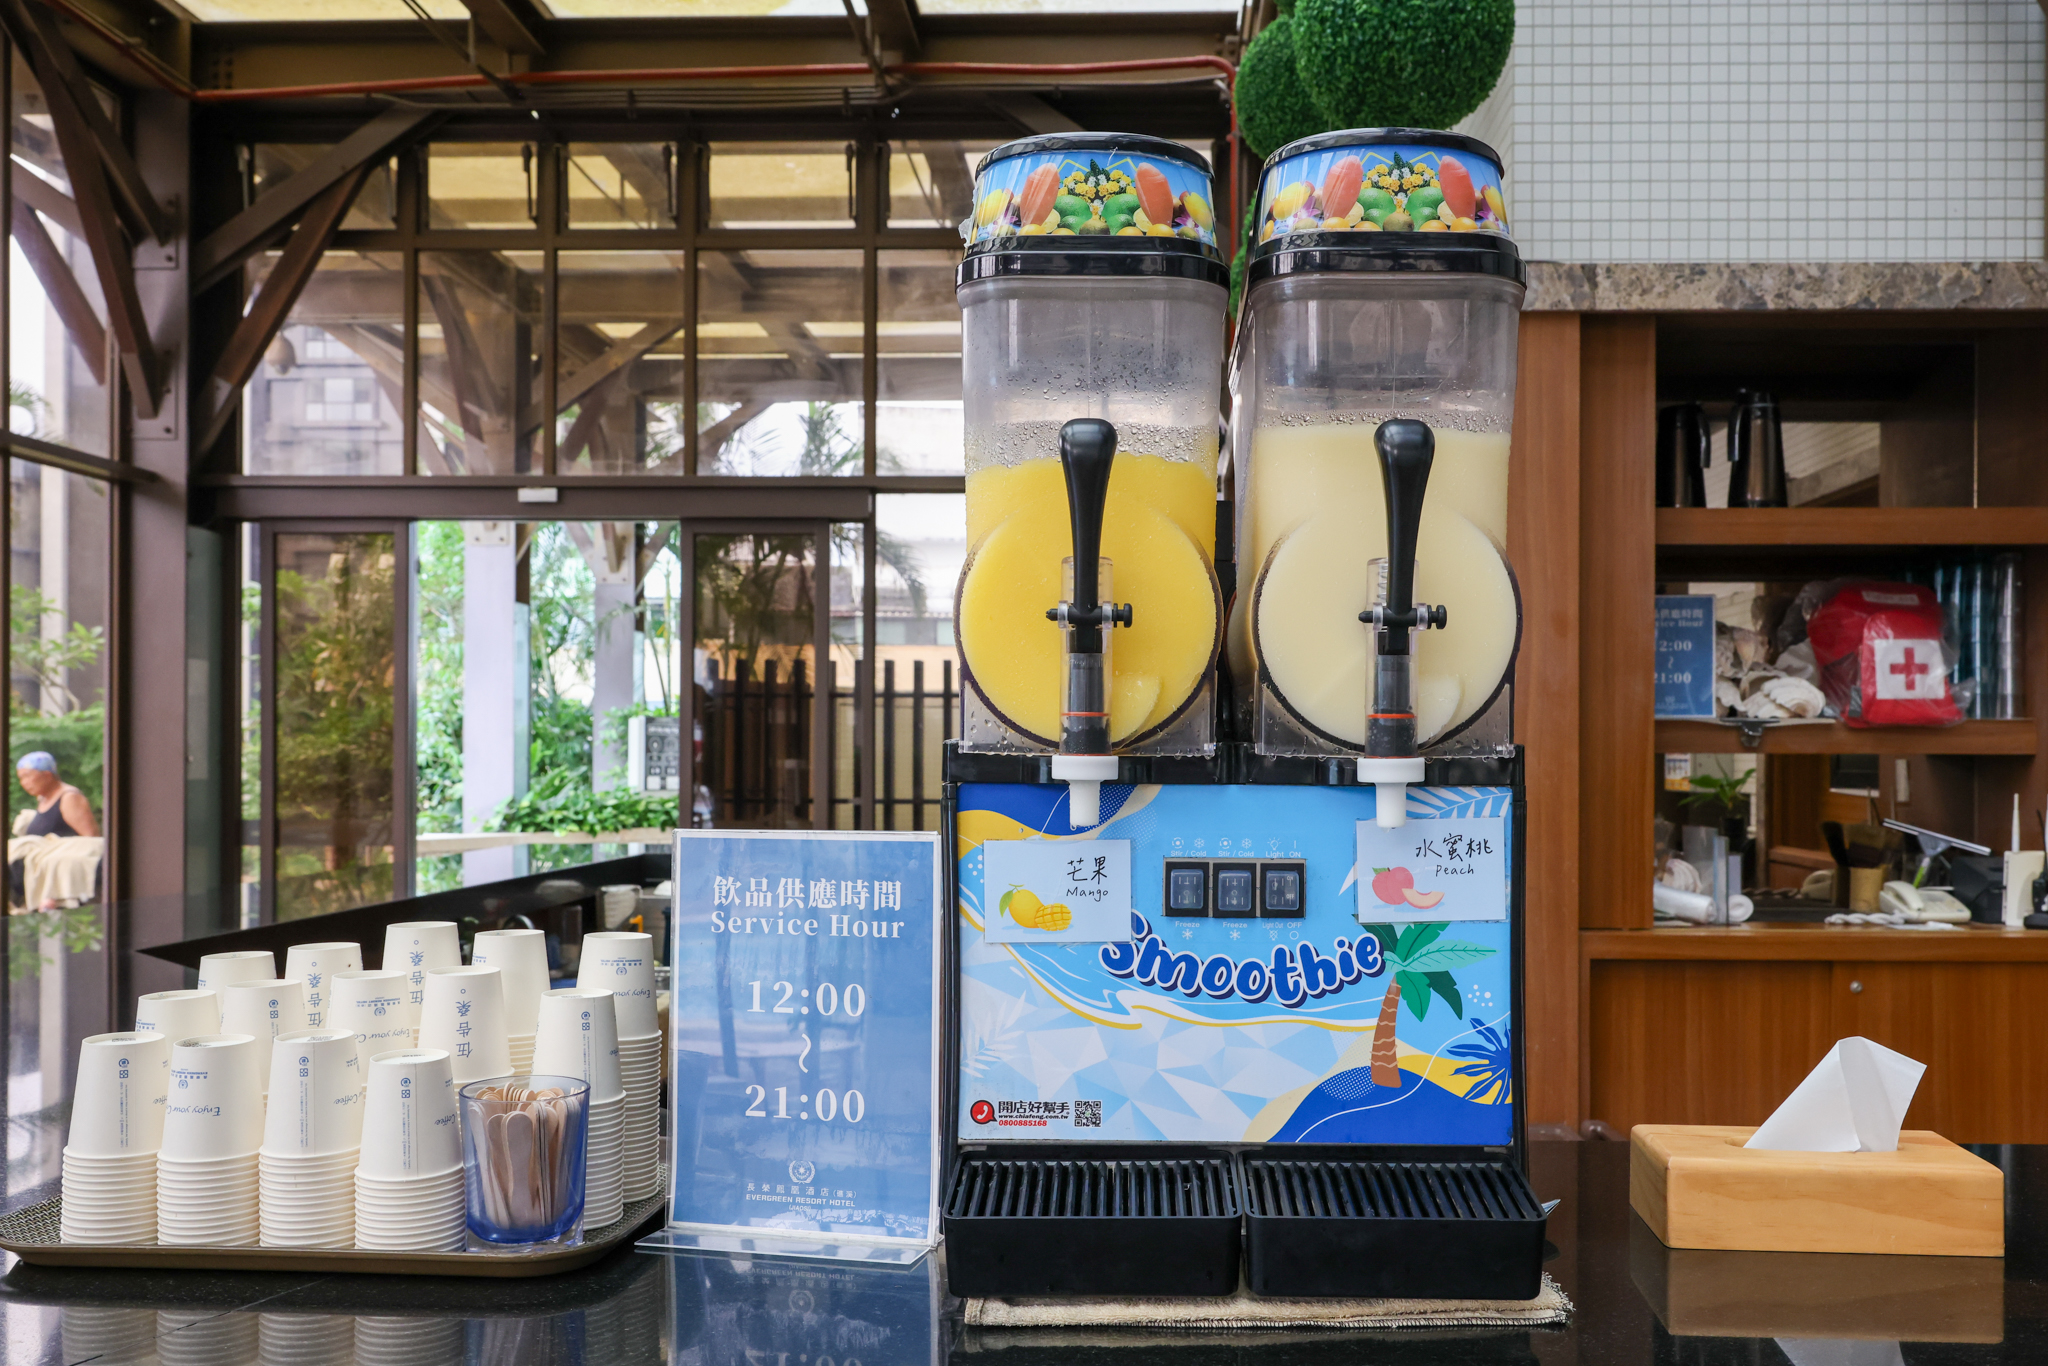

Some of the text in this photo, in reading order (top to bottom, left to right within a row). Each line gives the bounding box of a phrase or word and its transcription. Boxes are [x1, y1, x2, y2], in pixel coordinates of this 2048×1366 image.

[1656, 640, 1692, 652] 2:00
[1415, 832, 1493, 862] 水蜜桃
[1067, 855, 1108, 885] 芒果
[1435, 863, 1474, 877] Peach
[712, 875, 902, 912] 飲品供應時間
[1066, 886, 1109, 902] Mango
[710, 910, 905, 939] Service Hour
[1099, 909, 1385, 1007] Smoothie
[632, 988, 650, 998] Enjoy
[746, 980, 866, 1017] 12:00
[368, 1030, 391, 1040] your
[334, 1094, 358, 1106] Coffee
[744, 1084, 866, 1123] 21:00
[998, 1100, 1070, 1114] 開店好幫手
[192, 1105, 221, 1117] Enjoy
[434, 1114, 456, 1126] Coffee
[746, 1194, 856, 1208] EVERGREEN RESORT HOTEL
